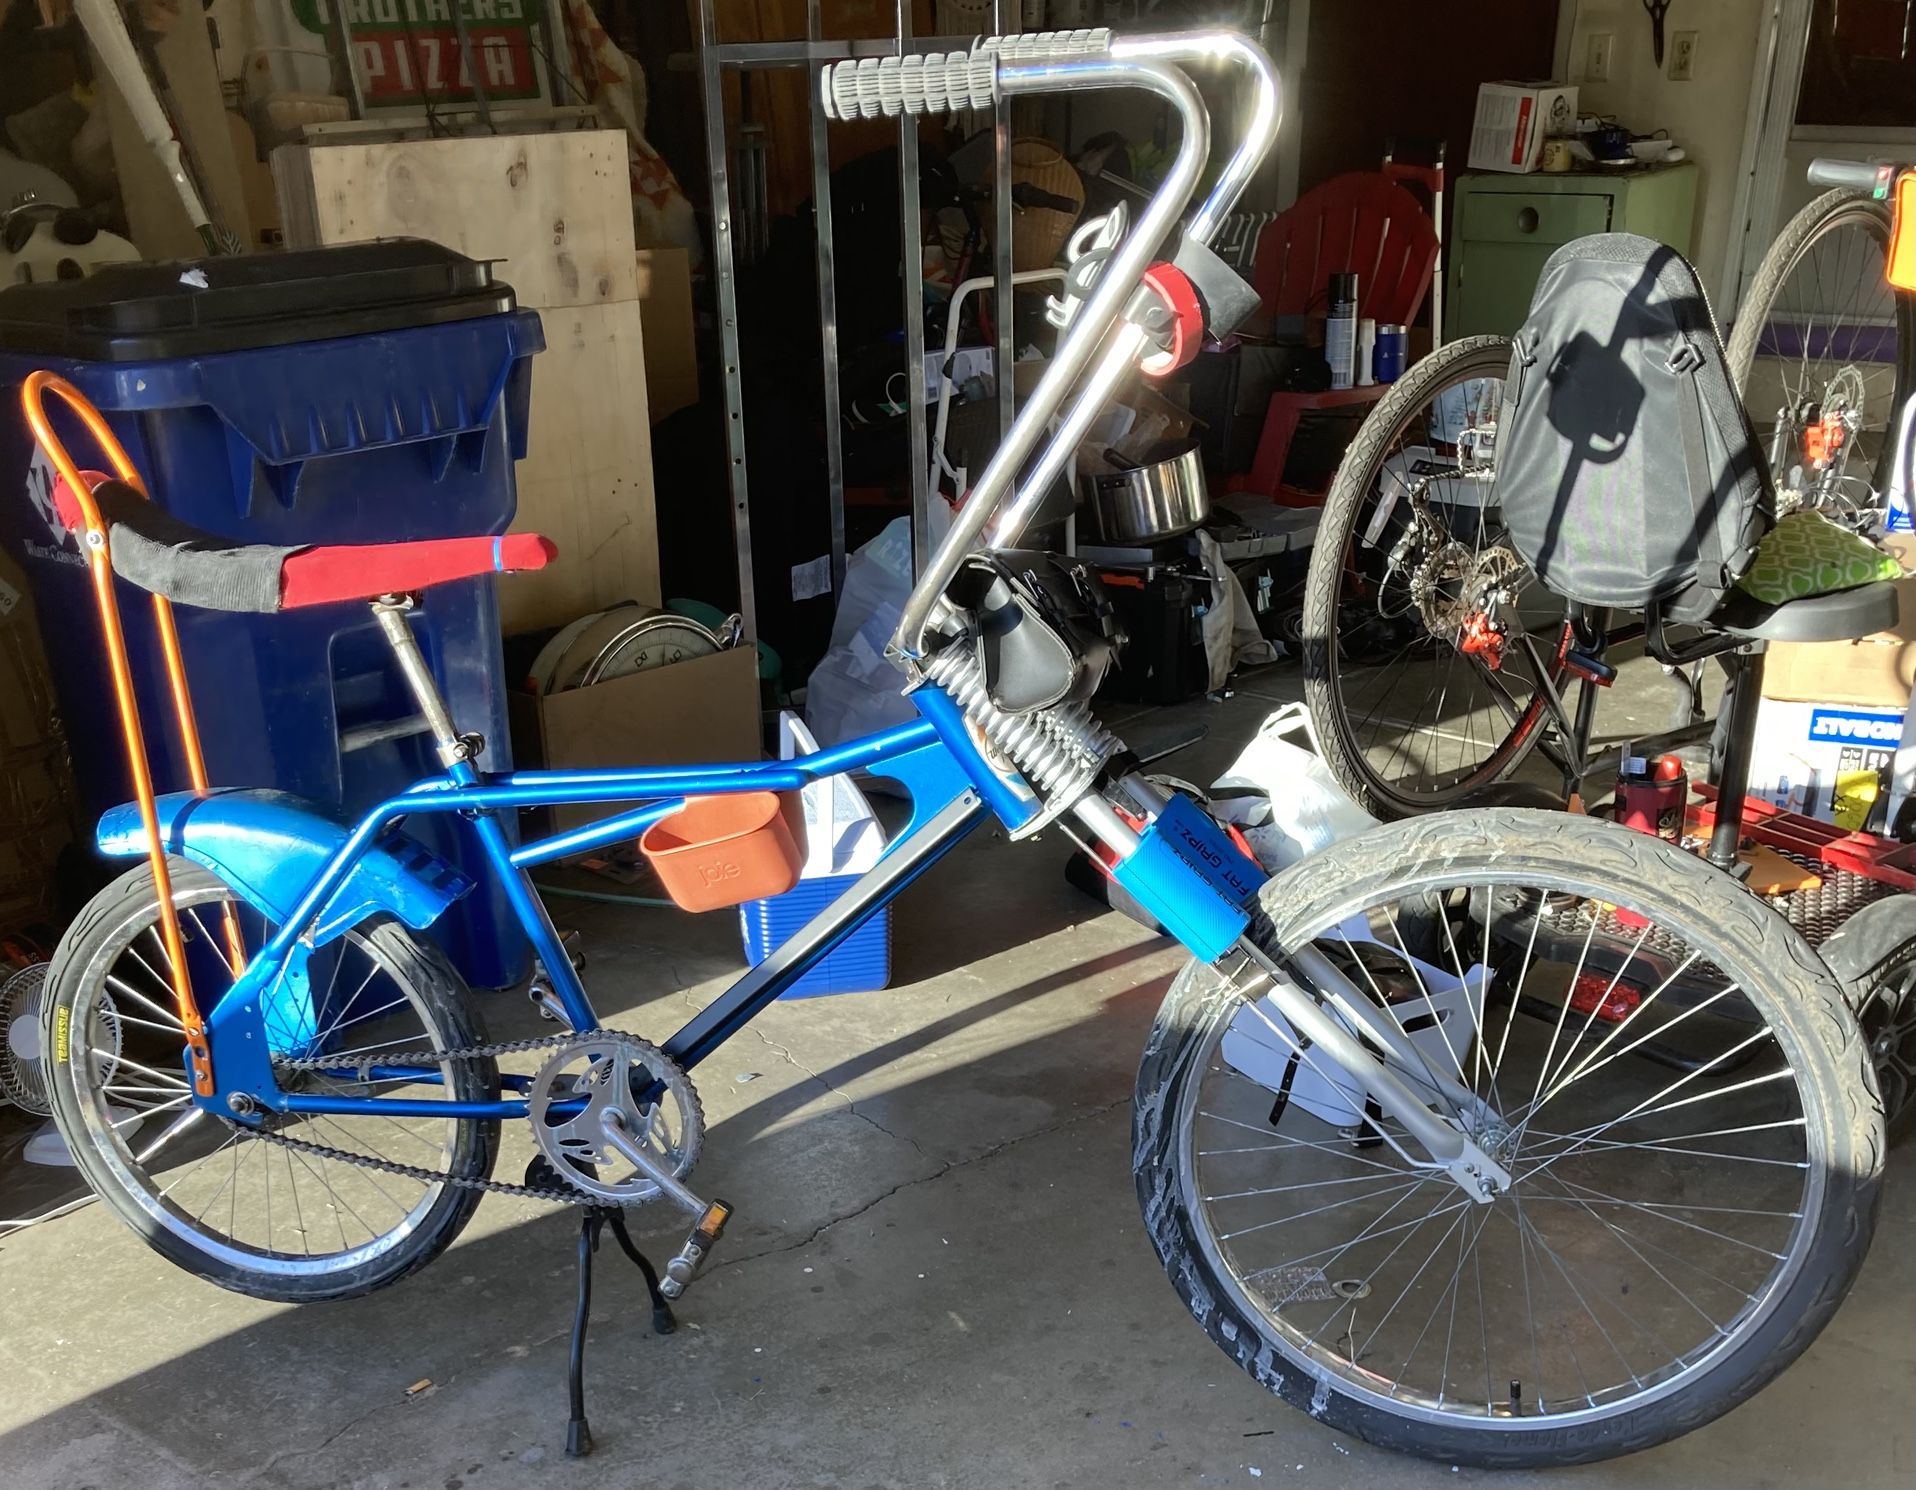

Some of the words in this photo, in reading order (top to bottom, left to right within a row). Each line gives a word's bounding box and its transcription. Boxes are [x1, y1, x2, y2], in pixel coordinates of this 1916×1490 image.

[316, 0, 523, 25] ROTHRS
[352, 35, 516, 94] PIZZA
[1180, 828, 1223, 869] GRIPZ
[697, 860, 741, 888] joie
[1222, 869, 1251, 897] FAT
